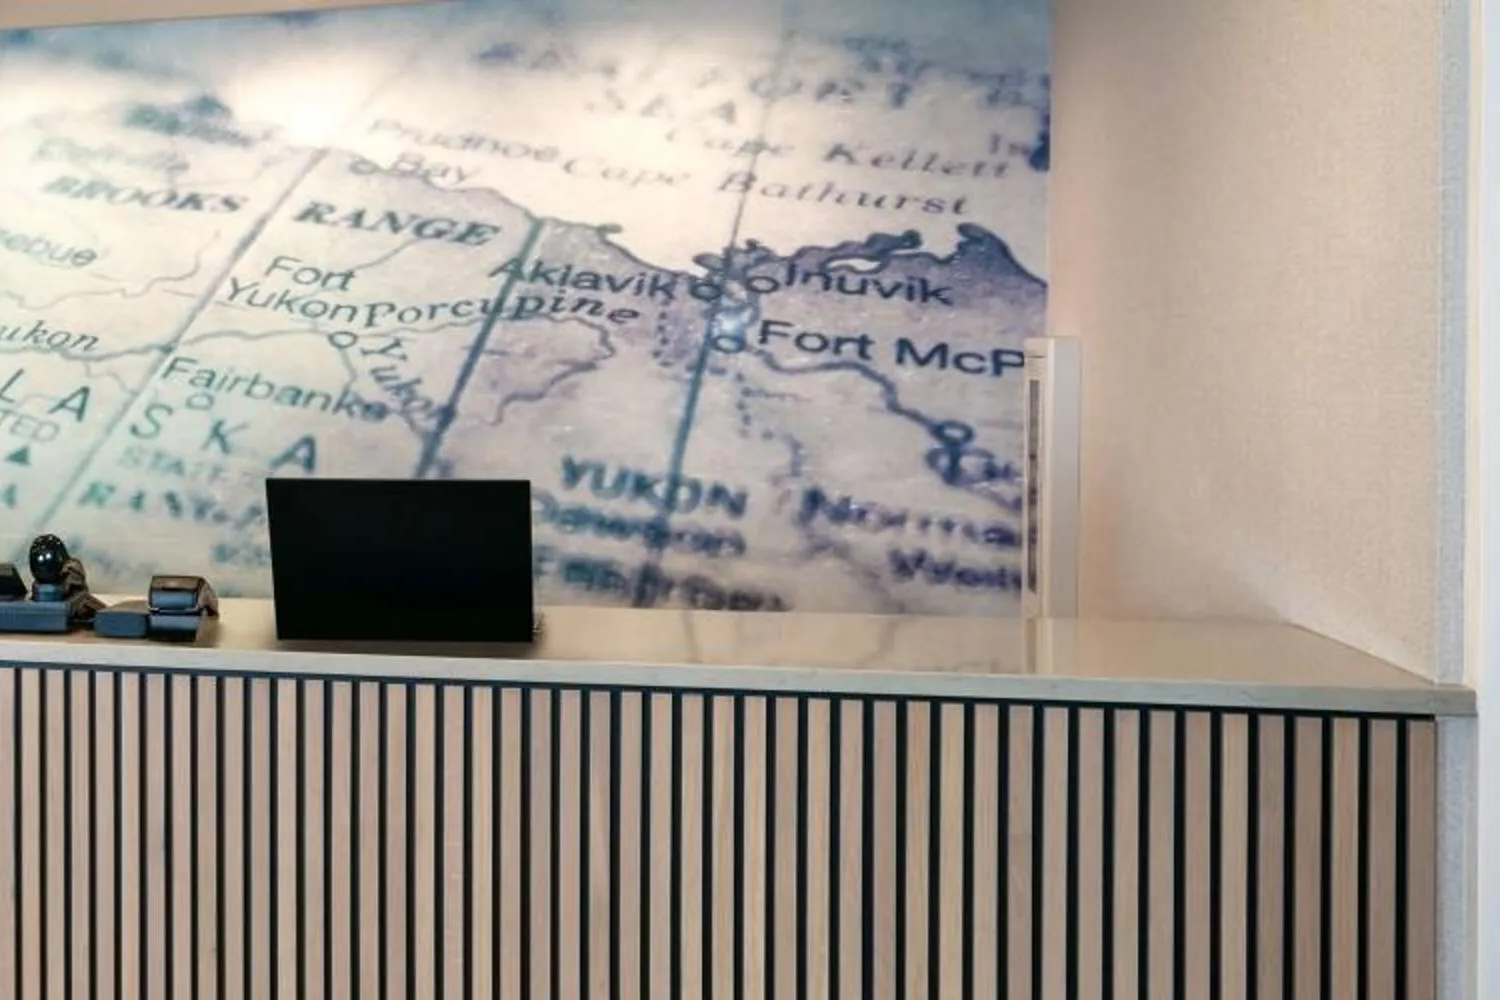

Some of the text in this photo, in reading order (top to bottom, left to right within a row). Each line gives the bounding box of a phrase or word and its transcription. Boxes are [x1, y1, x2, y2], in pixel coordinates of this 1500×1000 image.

[366, 119, 559, 162] Prudhoe
[823, 142, 1011, 180] Kellett
[42, 176, 502, 247] BROOKS RANGE
[715, 171, 972, 216] Bathurst
[265, 255, 356, 292] Fort
[487, 256, 676, 300] Aklavik
[784, 262, 955, 306] Inuvik
[226, 276, 358, 323] Yukon
[363, 289, 640, 326] Porcupine
[757, 319, 876, 362] Fort
[160, 356, 390, 422] Fairbanks
[560, 454, 749, 521] YUKON
